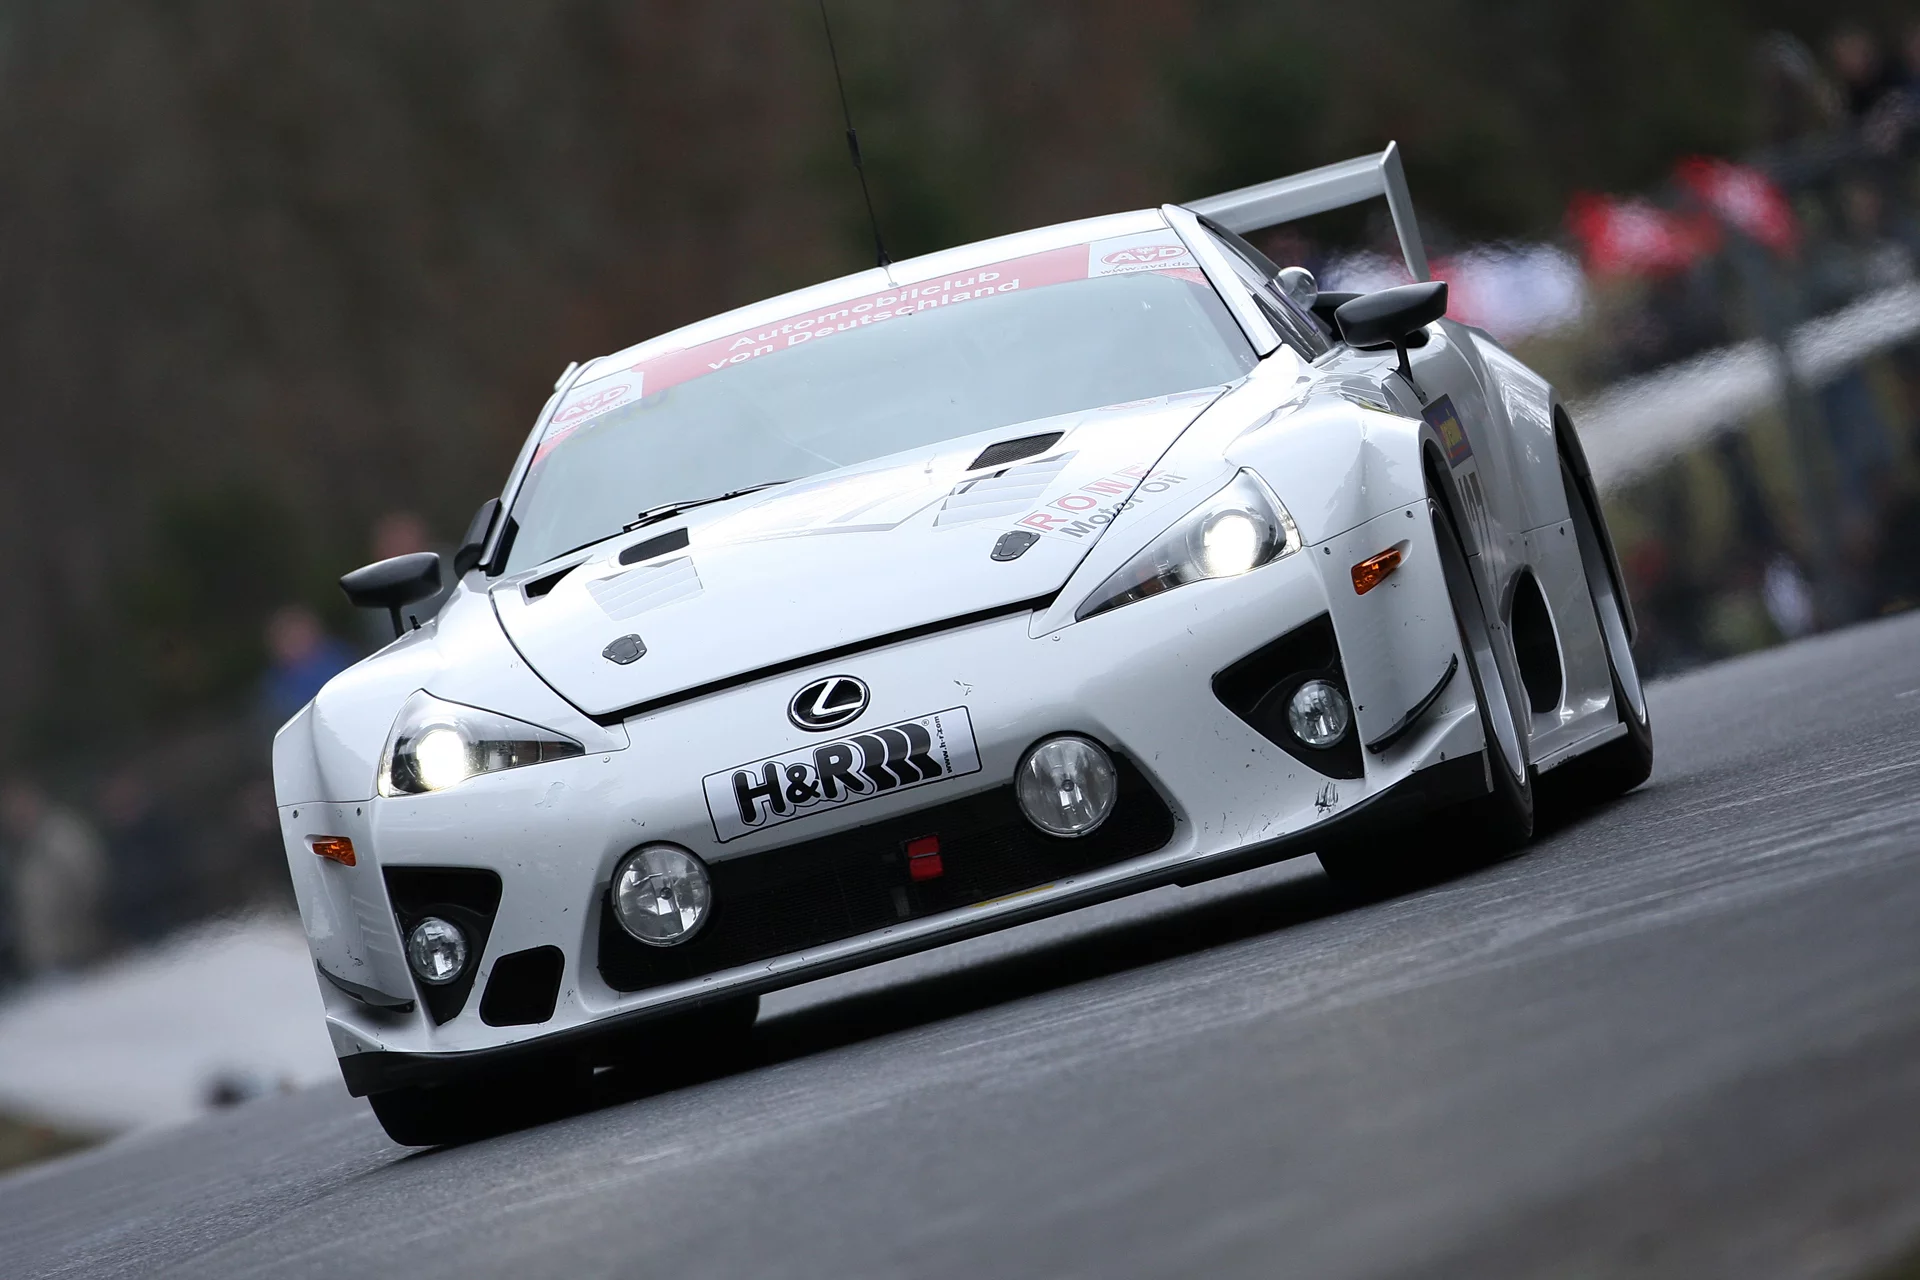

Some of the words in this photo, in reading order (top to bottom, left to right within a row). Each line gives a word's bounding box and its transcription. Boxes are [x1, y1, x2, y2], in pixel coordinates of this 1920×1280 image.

[1100, 261, 1190, 275] www.avd.de
[1110, 247, 1184, 263] AvD
[707, 344, 774, 370] von
[787, 278, 1021, 346] Deutschland
[728, 270, 1001, 352] Automobilclub
[559, 386, 629, 422] AvD
[1021, 463, 1166, 532] ROWE
[1059, 494, 1144, 538] Motor
[1140, 473, 1188, 493] Oil
[732, 740, 878, 826] H&R
